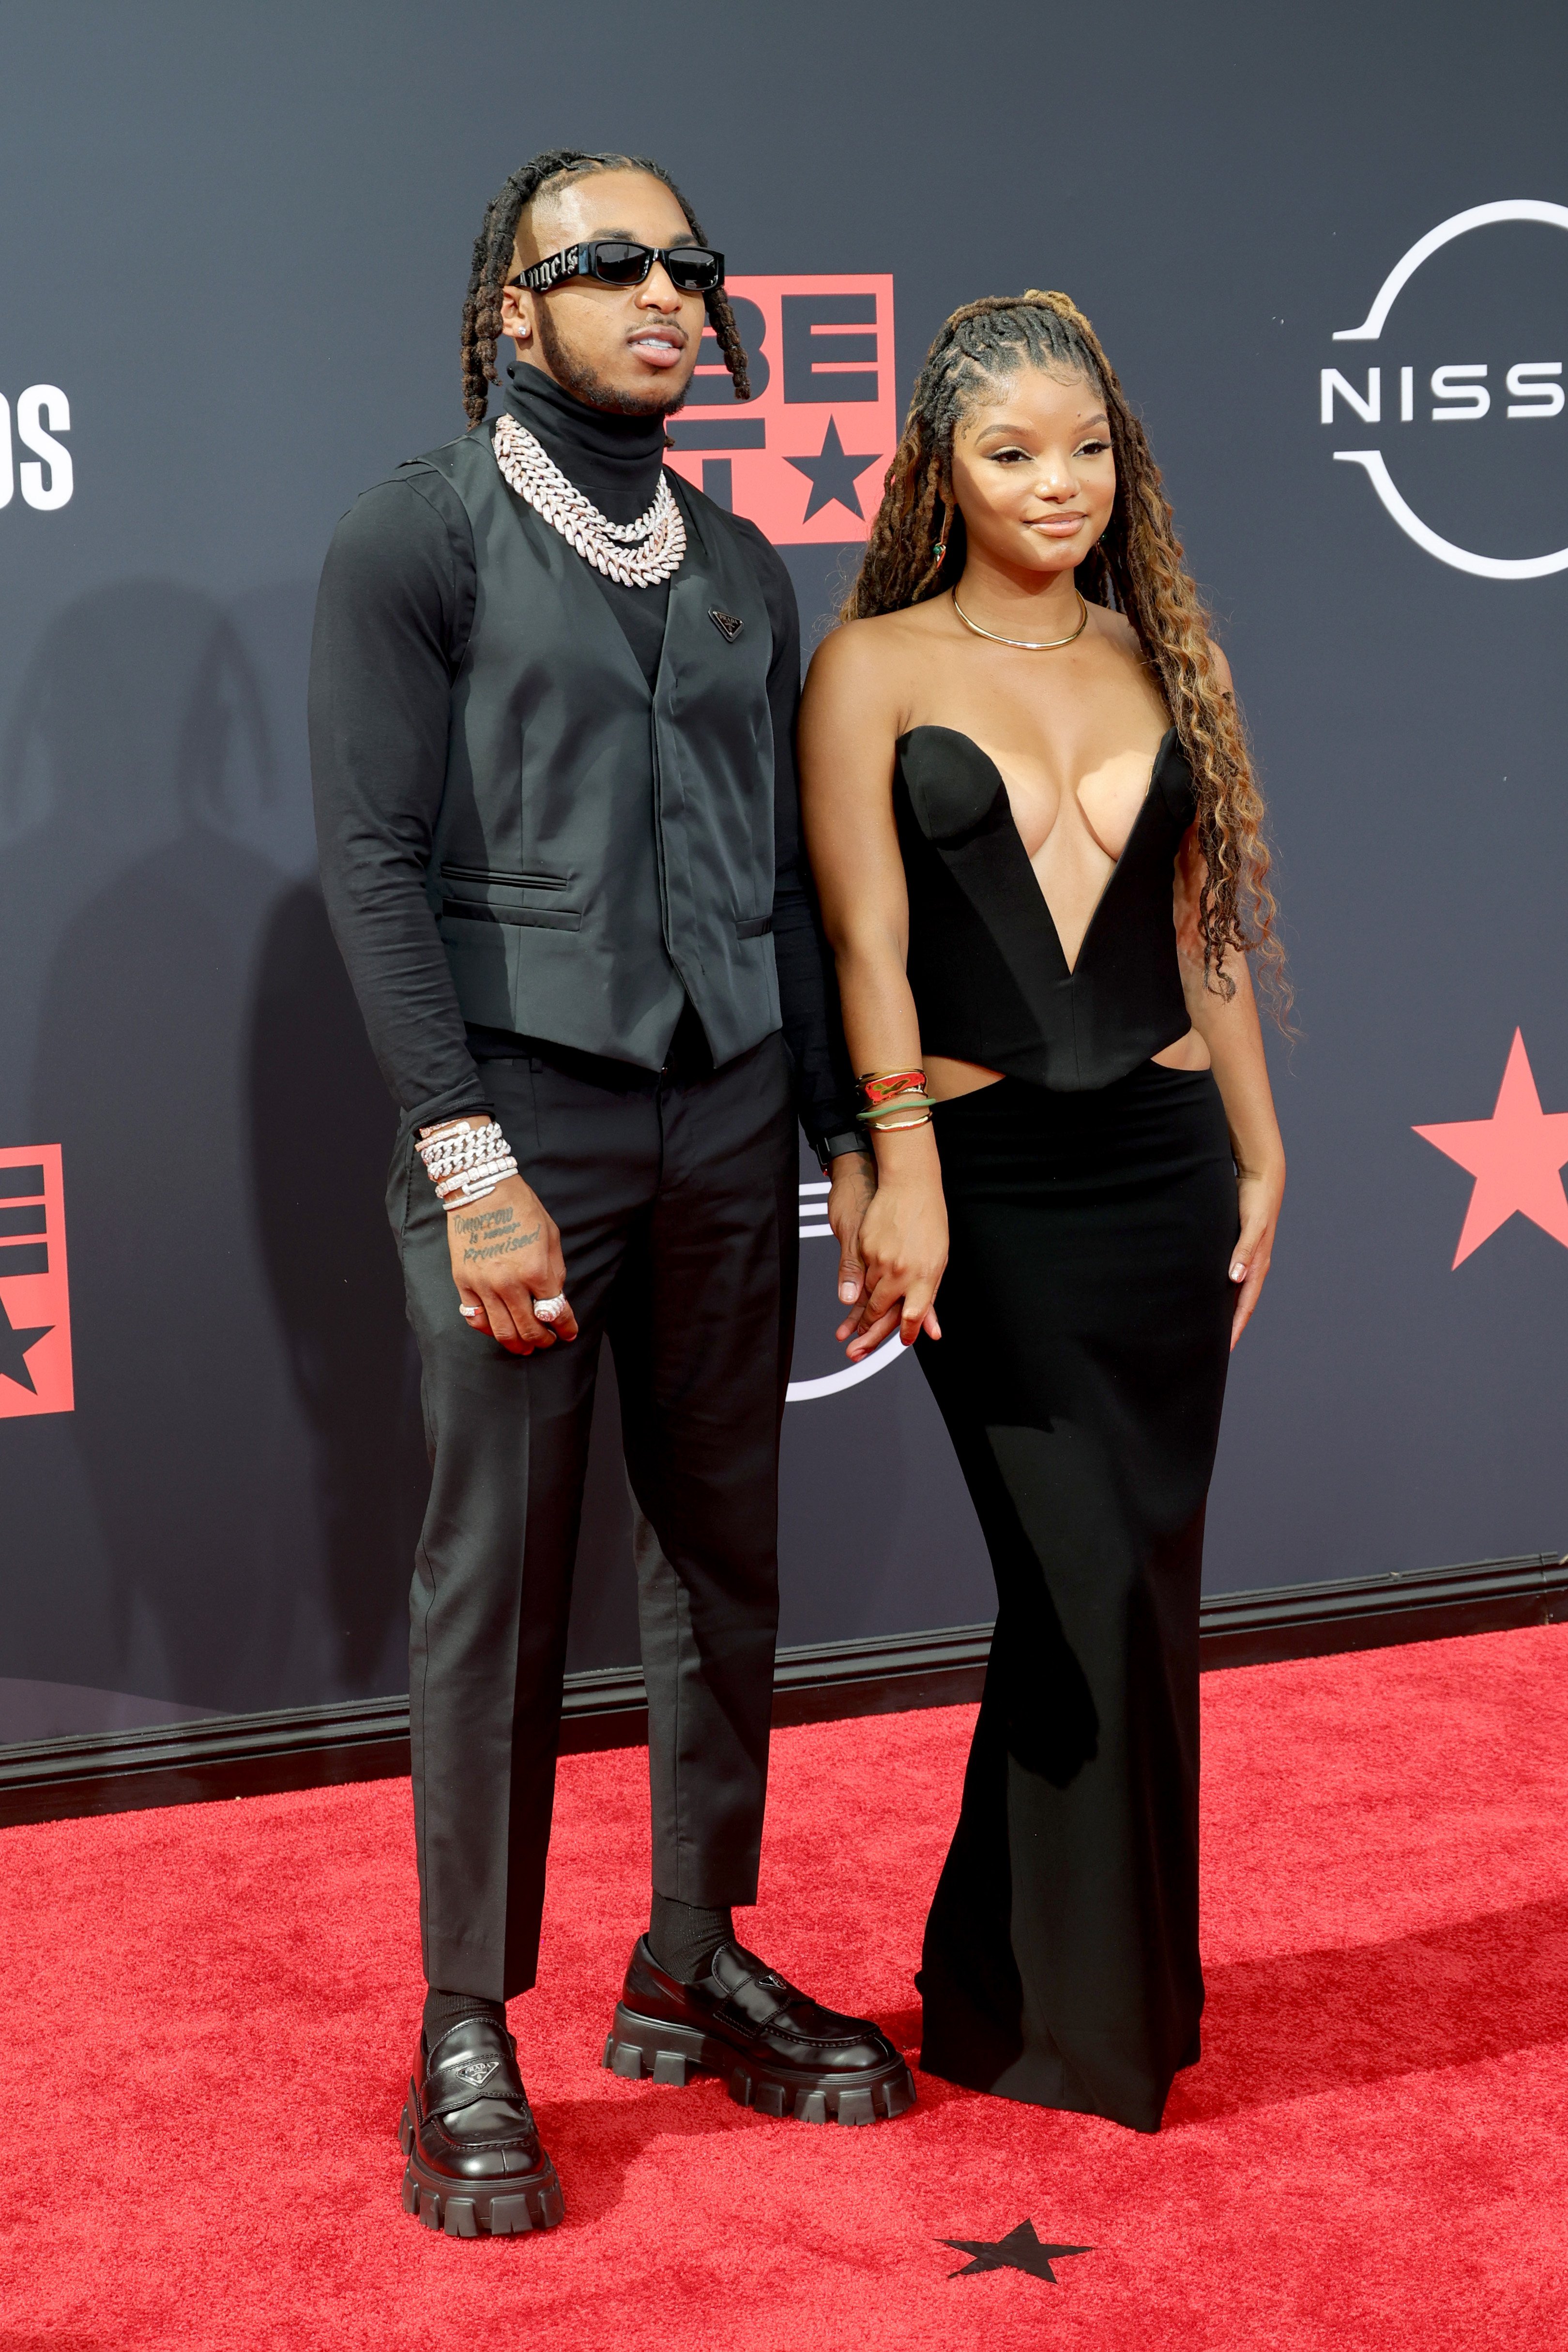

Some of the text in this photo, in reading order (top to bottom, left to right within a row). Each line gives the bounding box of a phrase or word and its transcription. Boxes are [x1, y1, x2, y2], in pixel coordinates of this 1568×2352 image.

[1321, 362, 1565, 424] NISS
[0, 384, 74, 511] S
[719, 614, 738, 625] PRADA
[453, 1206, 513, 1236] Tomorrow
